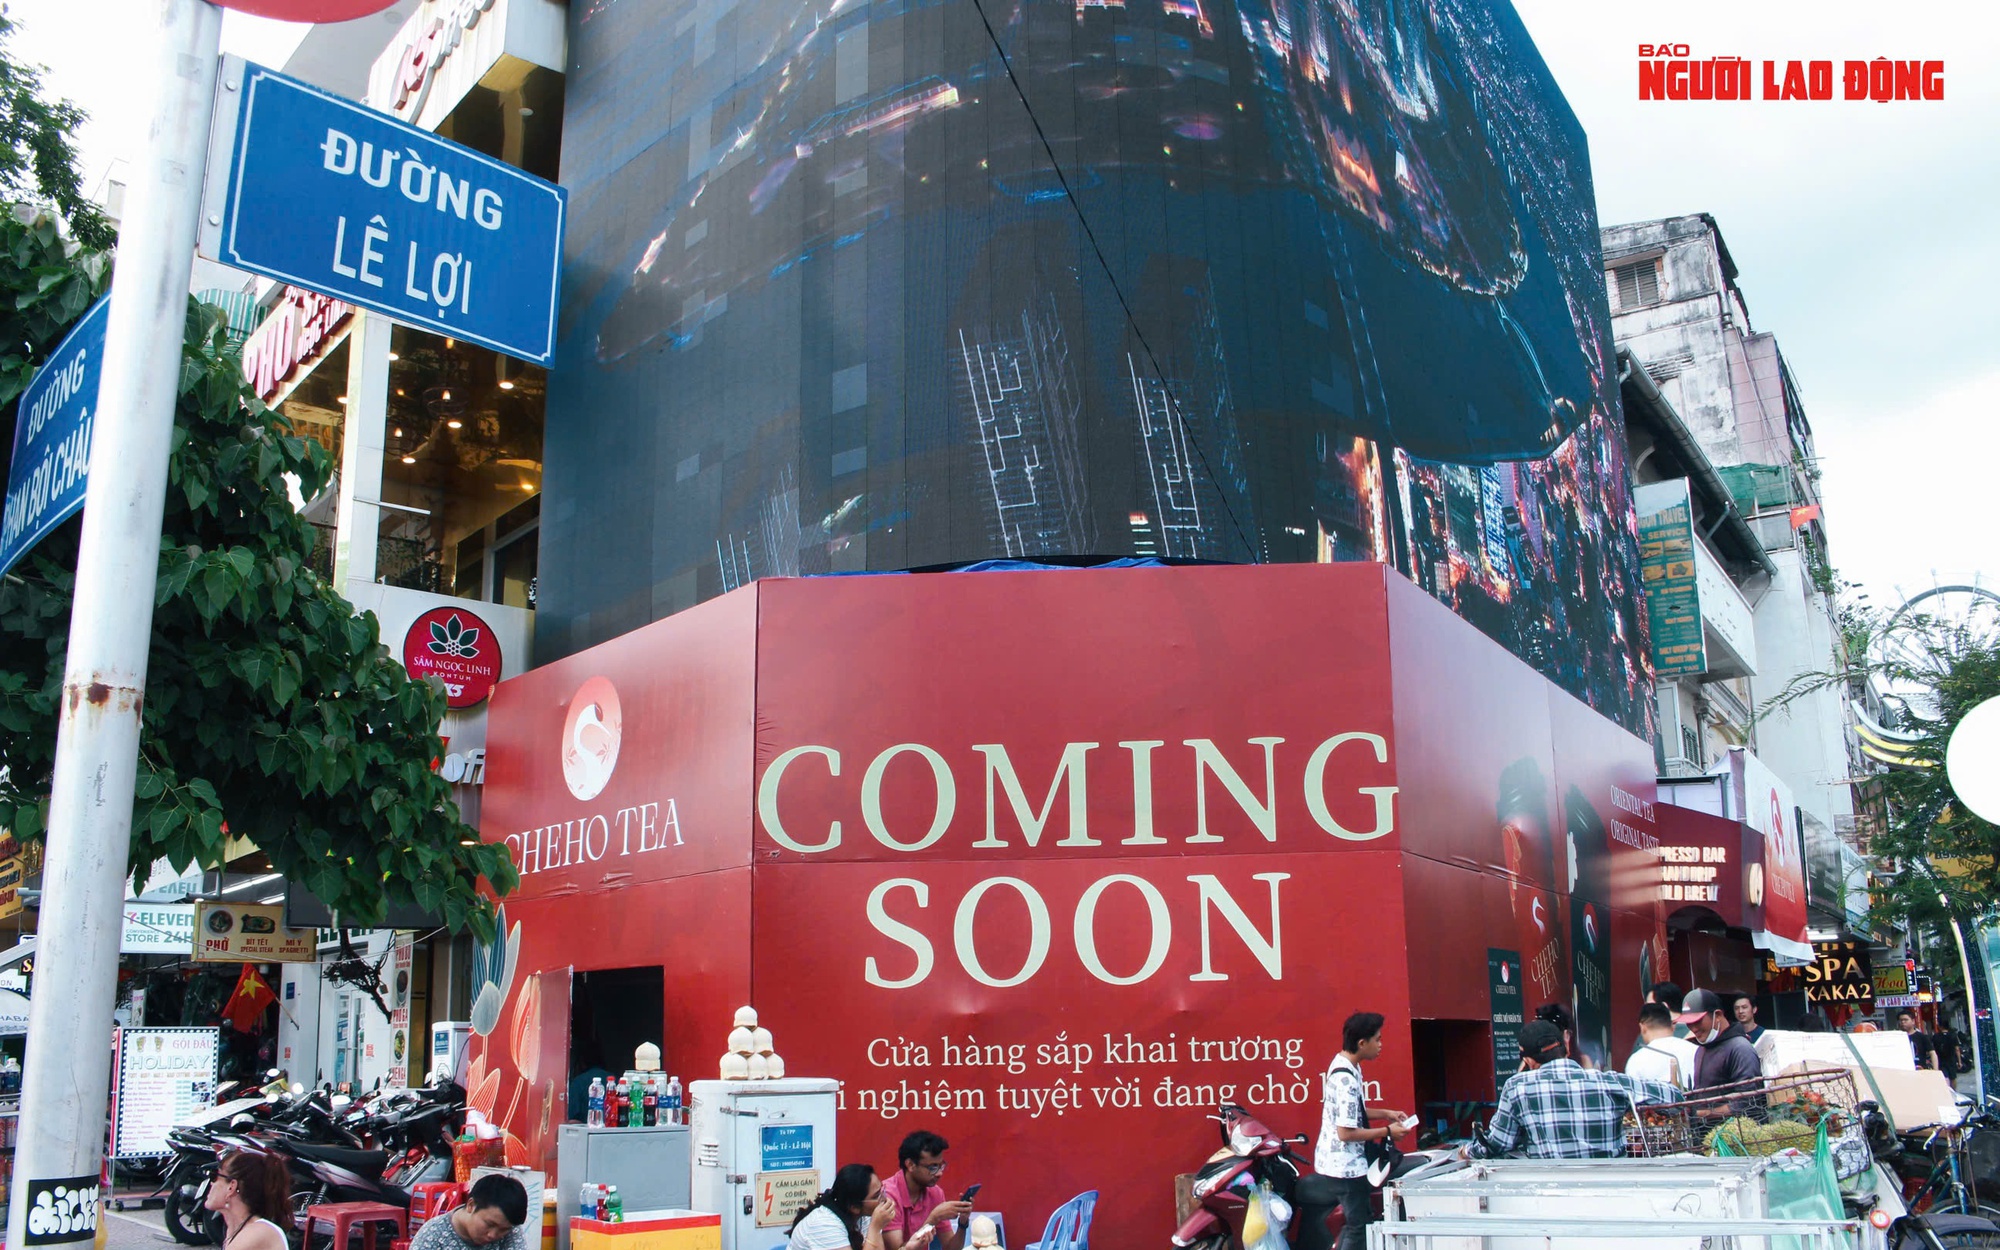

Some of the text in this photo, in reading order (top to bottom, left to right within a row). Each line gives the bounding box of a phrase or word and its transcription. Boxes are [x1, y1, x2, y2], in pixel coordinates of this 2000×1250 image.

[320, 128, 503, 230] ĐƯỜNG
[332, 215, 473, 318] LÊ LỢI
[27, 348, 87, 446] ĐƯỜNG
[26, 444, 54, 530] BỘI
[51, 406, 93, 502] CHÂU
[1647, 527, 1688, 540] SERVICE
[413, 655, 491, 676] SÂM NGỌC LINH
[433, 671, 472, 681] KONTUM
[757, 731, 1399, 853] COMING
[1610, 785, 1656, 823] ORIENTAL TEA
[503, 797, 685, 876] CHEHO TEA
[1610, 819, 1642, 850] ORIGINAL
[1702, 847, 1726, 863] BAR
[1684, 885, 1719, 902] BREW
[125, 930, 194, 944] STORE 24H
[206, 937, 230, 952] PHỞ
[864, 872, 1291, 989] SOON
[1531, 938, 1559, 982] CHEHO
[1804, 957, 1866, 982] SPA
[1803, 983, 1872, 1002] KAKA2
[130, 1055, 210, 1070] HOLIDAY
[867, 1031, 1304, 1075] Cửa hàng sắp khai trương
[857, 1080, 988, 1119] nghiệm
[996, 1081, 1083, 1118] tuyệt
[1093, 1079, 1143, 1108] vời
[1153, 1078, 1237, 1107] đang
[1247, 1072, 1310, 1105] chờ
[763, 1142, 779, 1152] Quốc
[775, 1180, 790, 1188] CẤM
